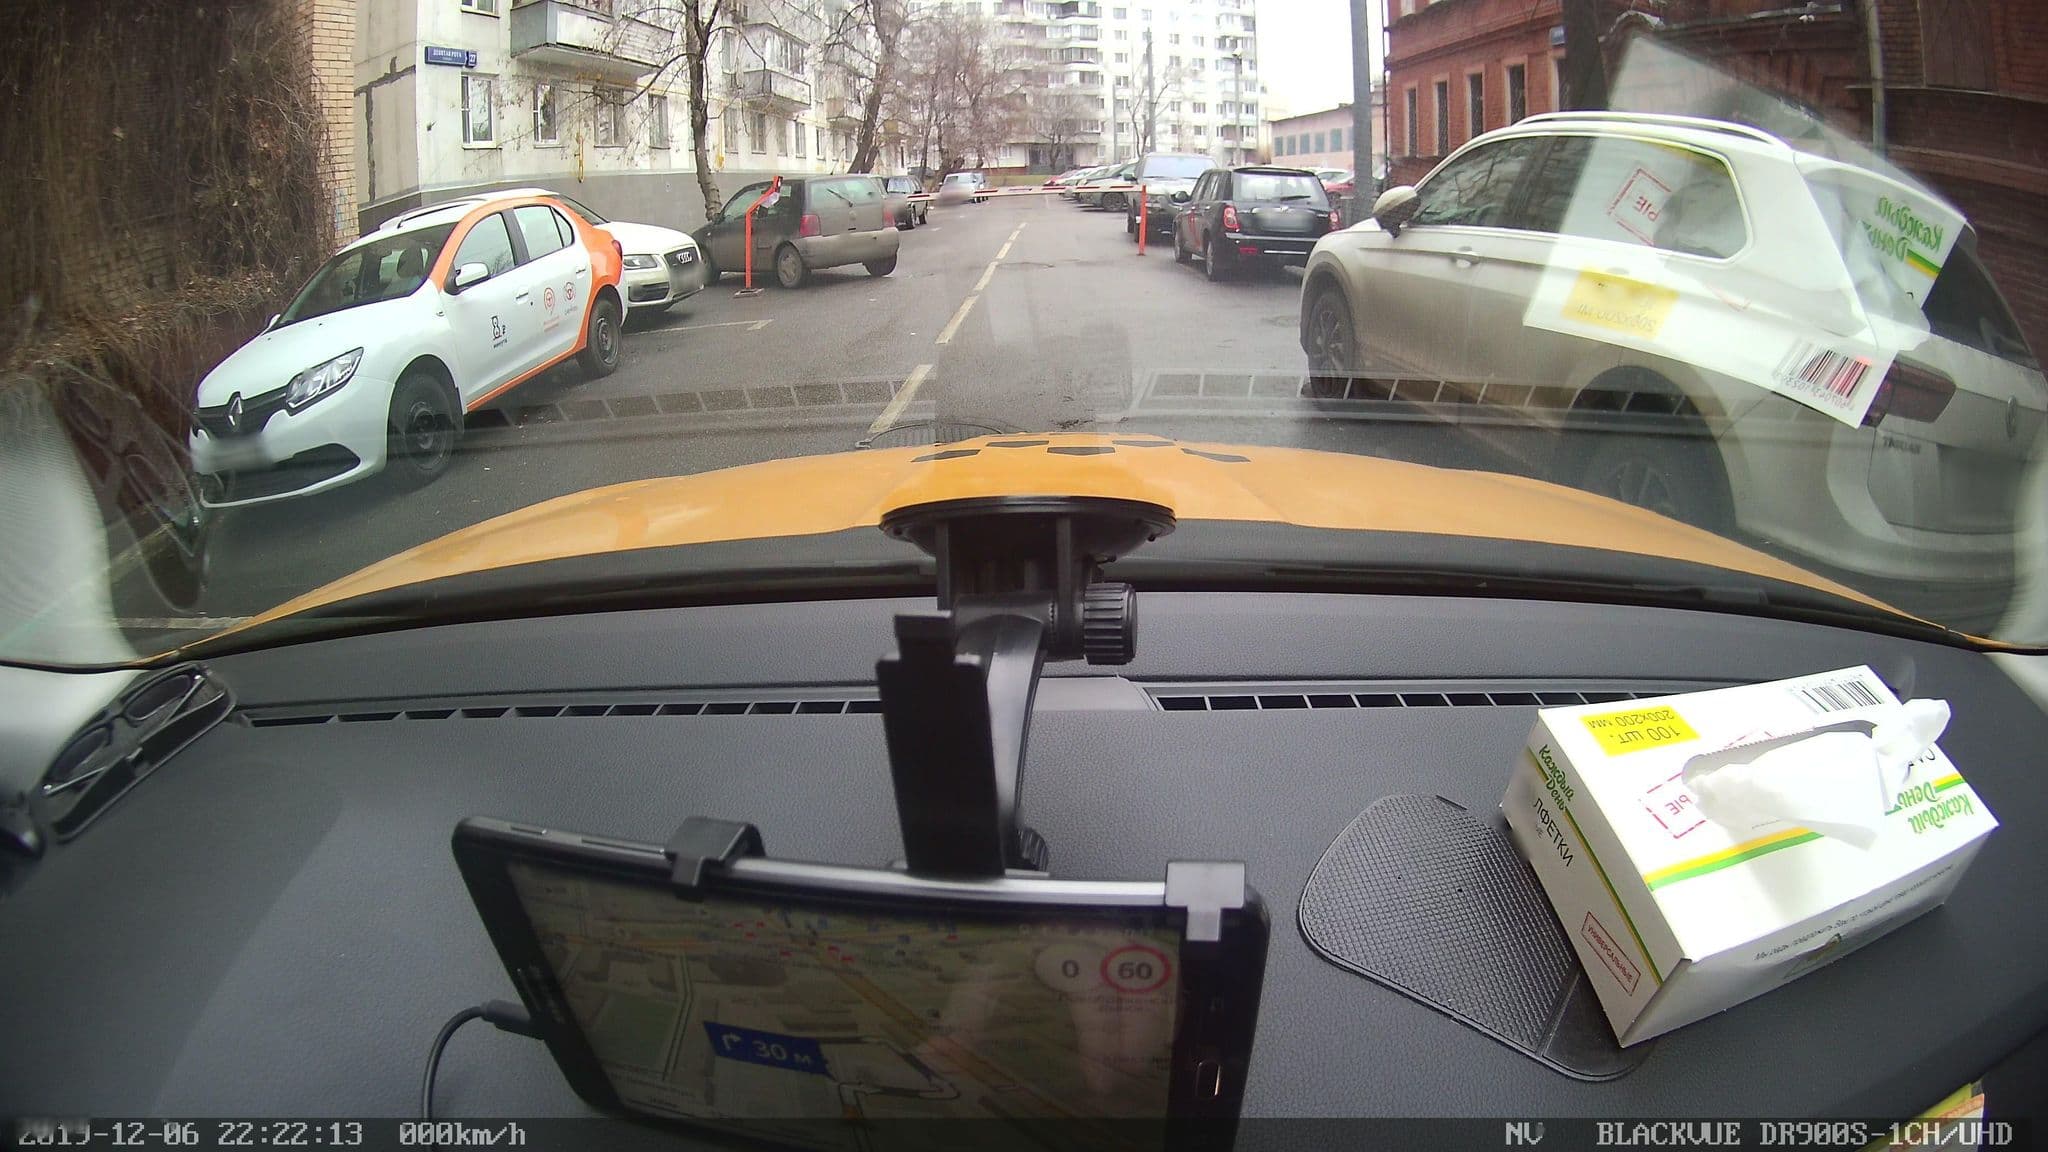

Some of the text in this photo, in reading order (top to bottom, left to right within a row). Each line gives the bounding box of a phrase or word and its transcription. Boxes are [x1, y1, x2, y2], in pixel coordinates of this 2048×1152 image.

[1646, 726, 1681, 741] 100
[1538, 744, 1576, 802] Каждый
[1546, 774, 1567, 811] День
[1897, 782, 1941, 808] День
[1907, 793, 1975, 834] Каждый
[1062, 959, 1080, 978] 0
[1117, 961, 1153, 980] 60
[751, 1040, 788, 1061] 30
